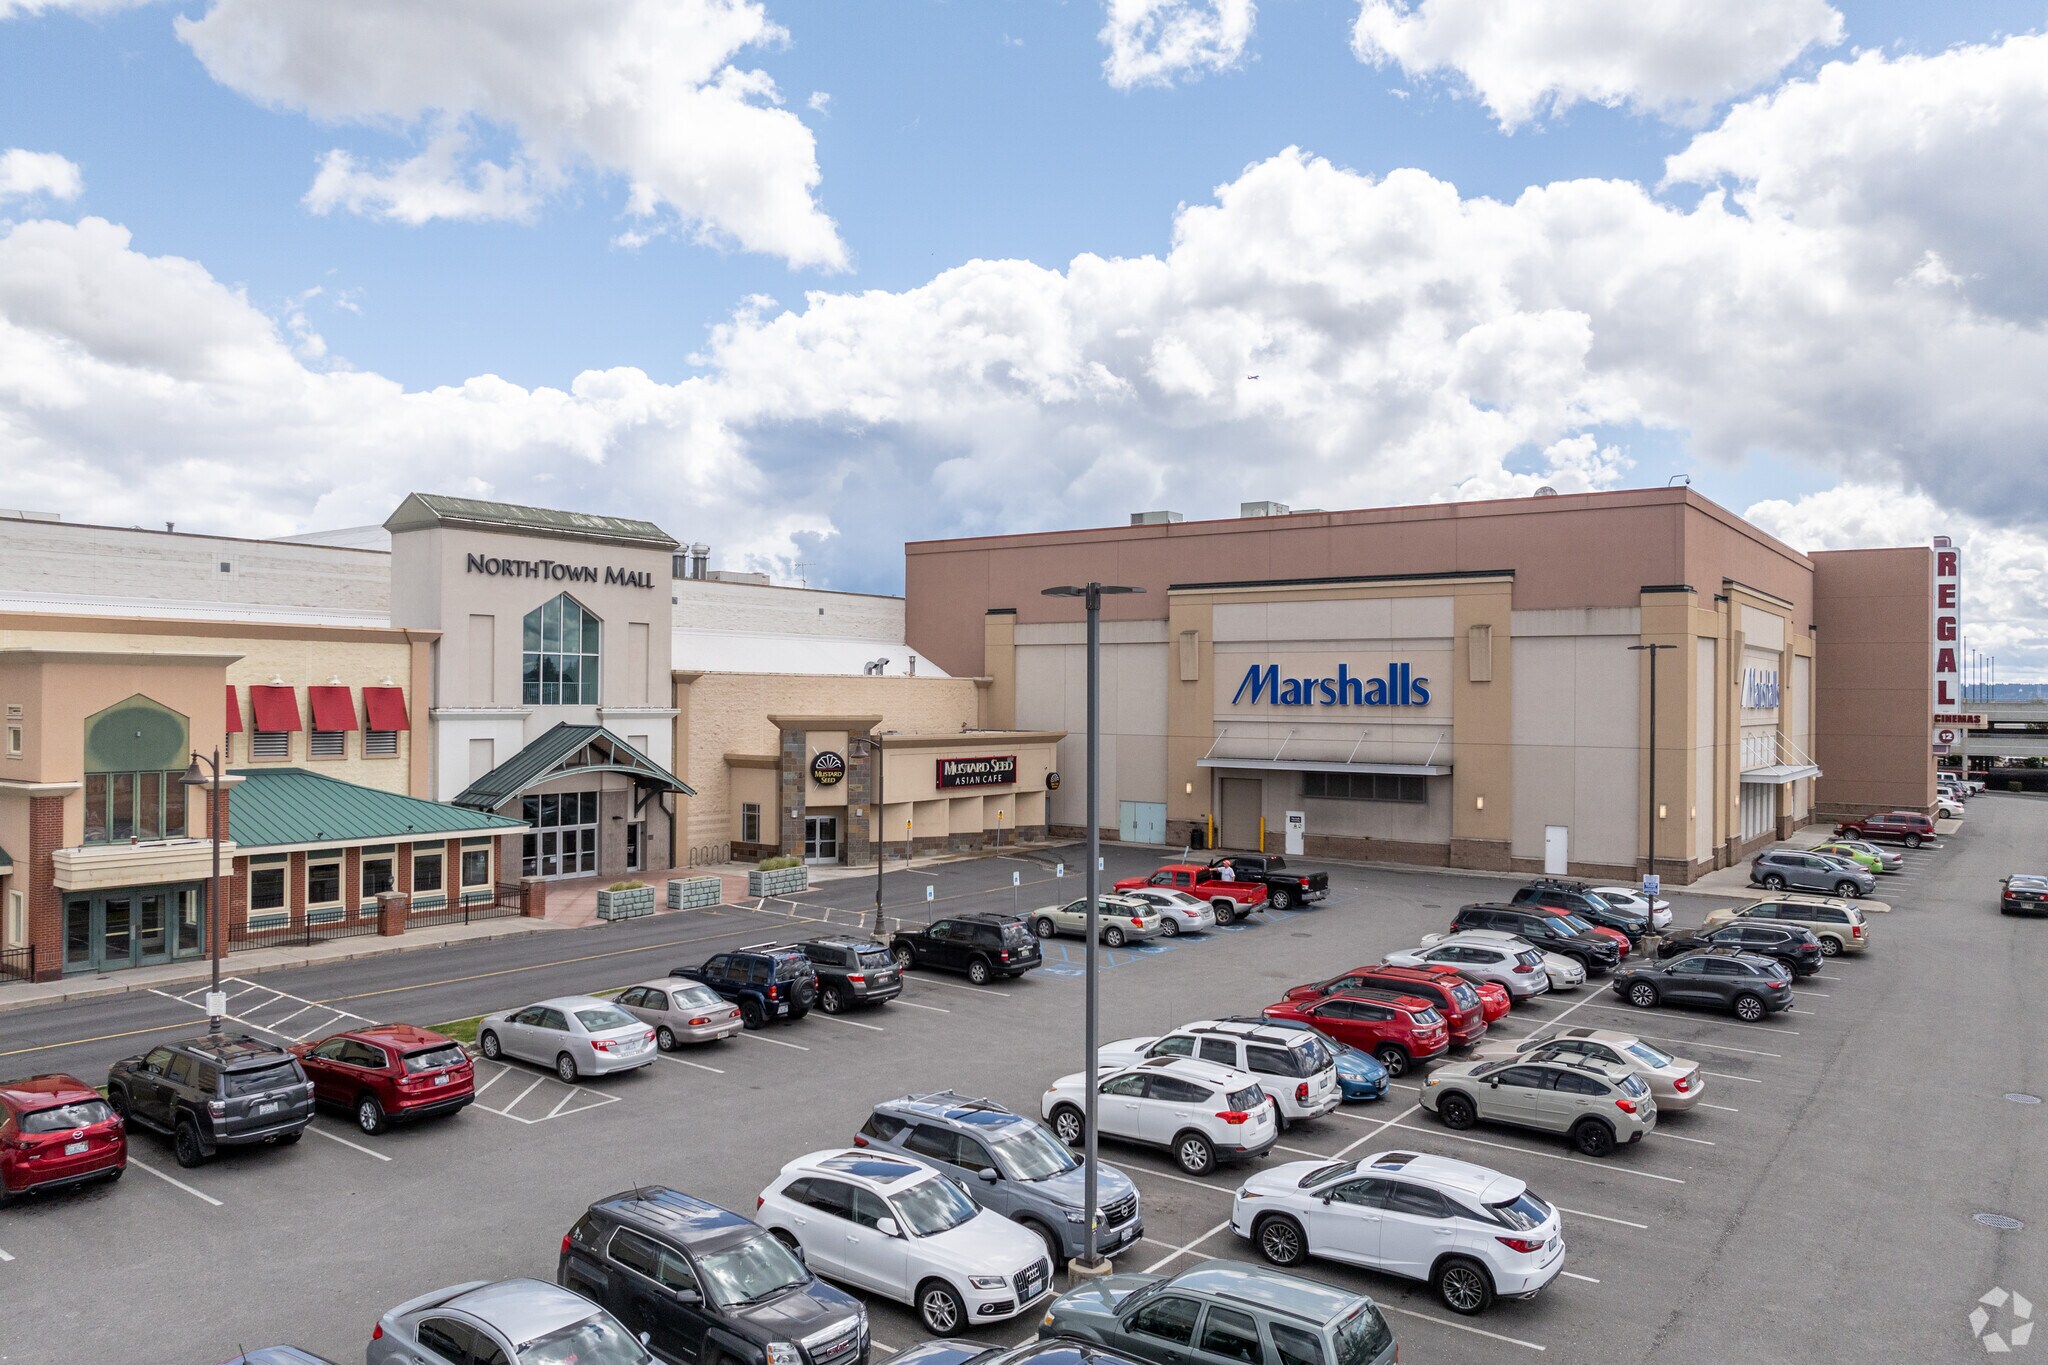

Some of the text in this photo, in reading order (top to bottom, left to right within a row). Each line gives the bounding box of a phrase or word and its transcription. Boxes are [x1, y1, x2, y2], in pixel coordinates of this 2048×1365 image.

[467, 552, 655, 588] NORTHTOWN MALL
[1936, 552, 1957, 705] REGAL
[1232, 662, 1432, 706] Marshalls
[1934, 714, 1981, 723] CINEMAS
[944, 759, 1014, 775] MUSTARD SEED
[955, 774, 1003, 785] ASIAN CAFE
